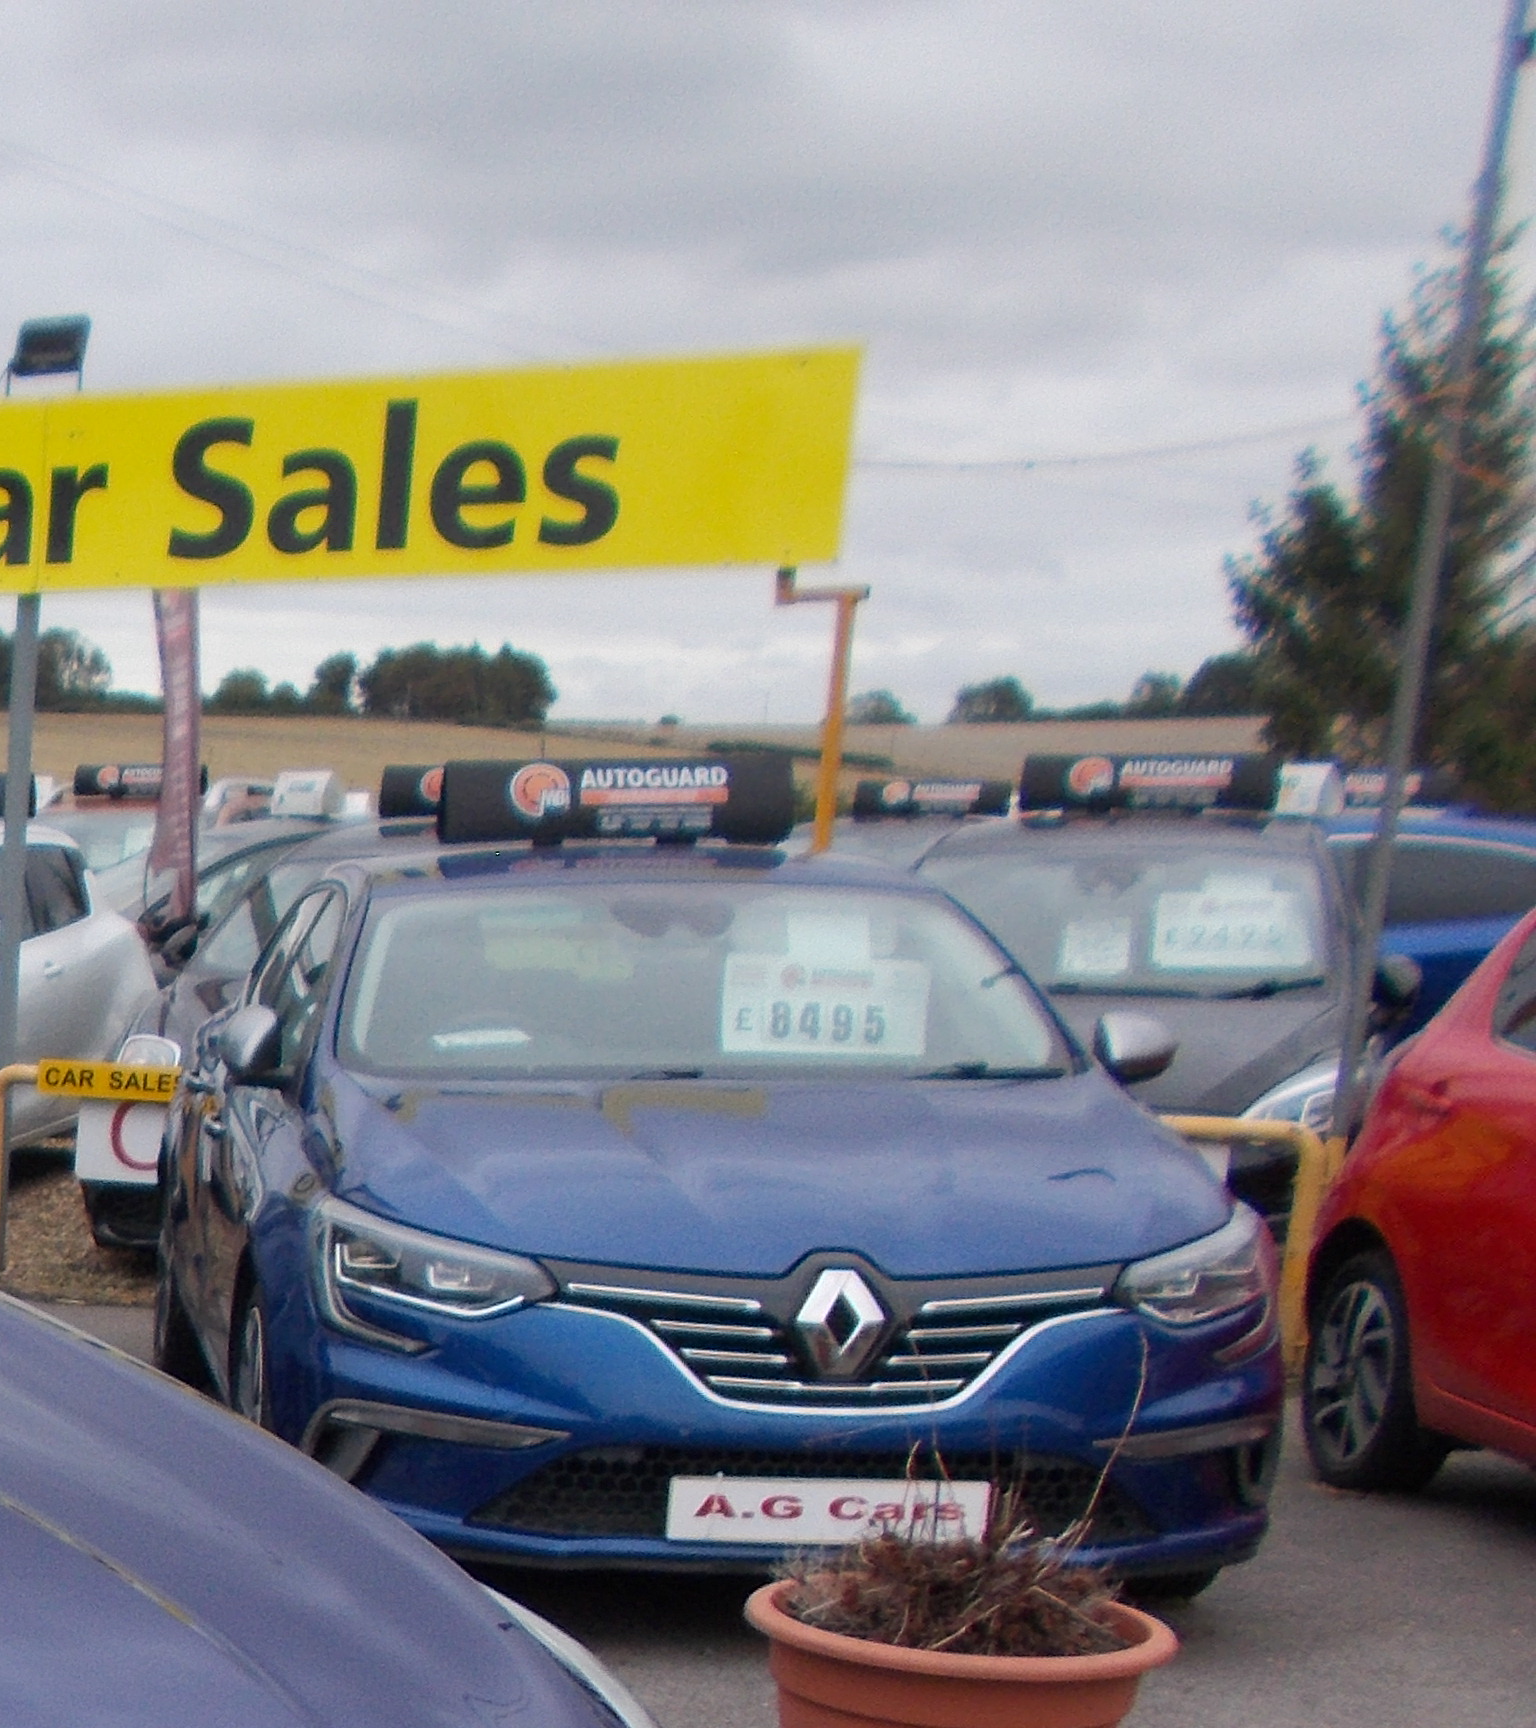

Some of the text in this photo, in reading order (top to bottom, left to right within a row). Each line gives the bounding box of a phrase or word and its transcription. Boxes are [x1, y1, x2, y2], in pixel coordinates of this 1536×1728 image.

[166, 398, 621, 561] Sales
[581, 765, 729, 788] AUTOGUARD
[1123, 759, 1232, 776] AUTOGUARD
[45, 1066, 95, 1087] CAR
[693, 1493, 966, 1521] A.G Cars
